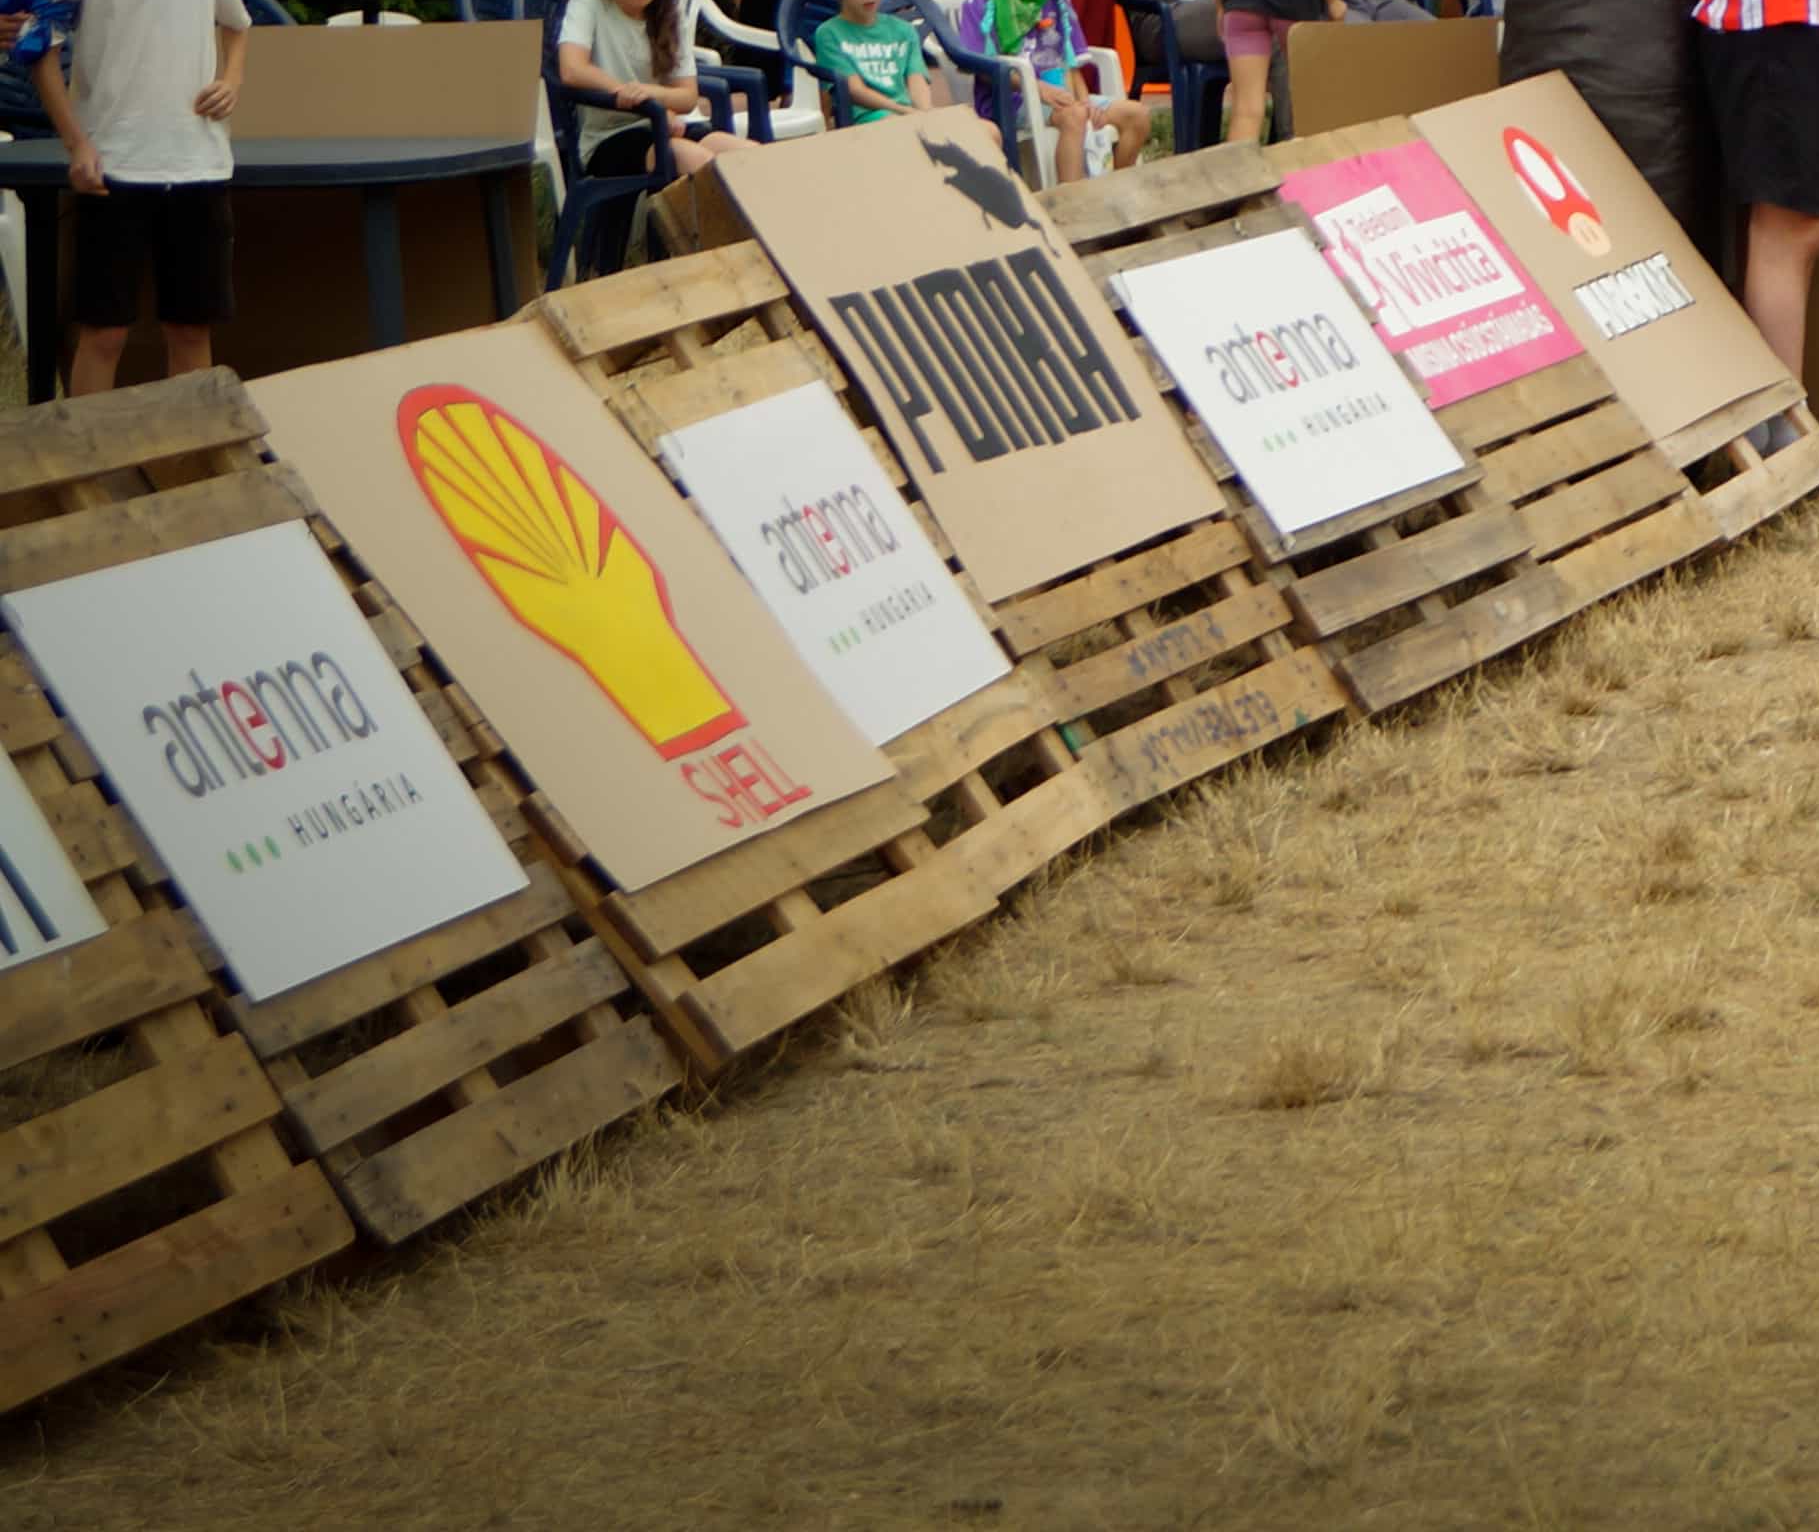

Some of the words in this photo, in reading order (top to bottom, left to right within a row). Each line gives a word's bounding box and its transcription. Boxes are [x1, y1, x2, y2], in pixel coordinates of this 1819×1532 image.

[828, 246, 1142, 475] PUMBA
[1205, 310, 1361, 406] antenna
[760, 483, 902, 595] antenna
[142, 649, 378, 799] antenna
[289, 770, 424, 849] HUNGÁRIA
[680, 737, 813, 831] SHELL
